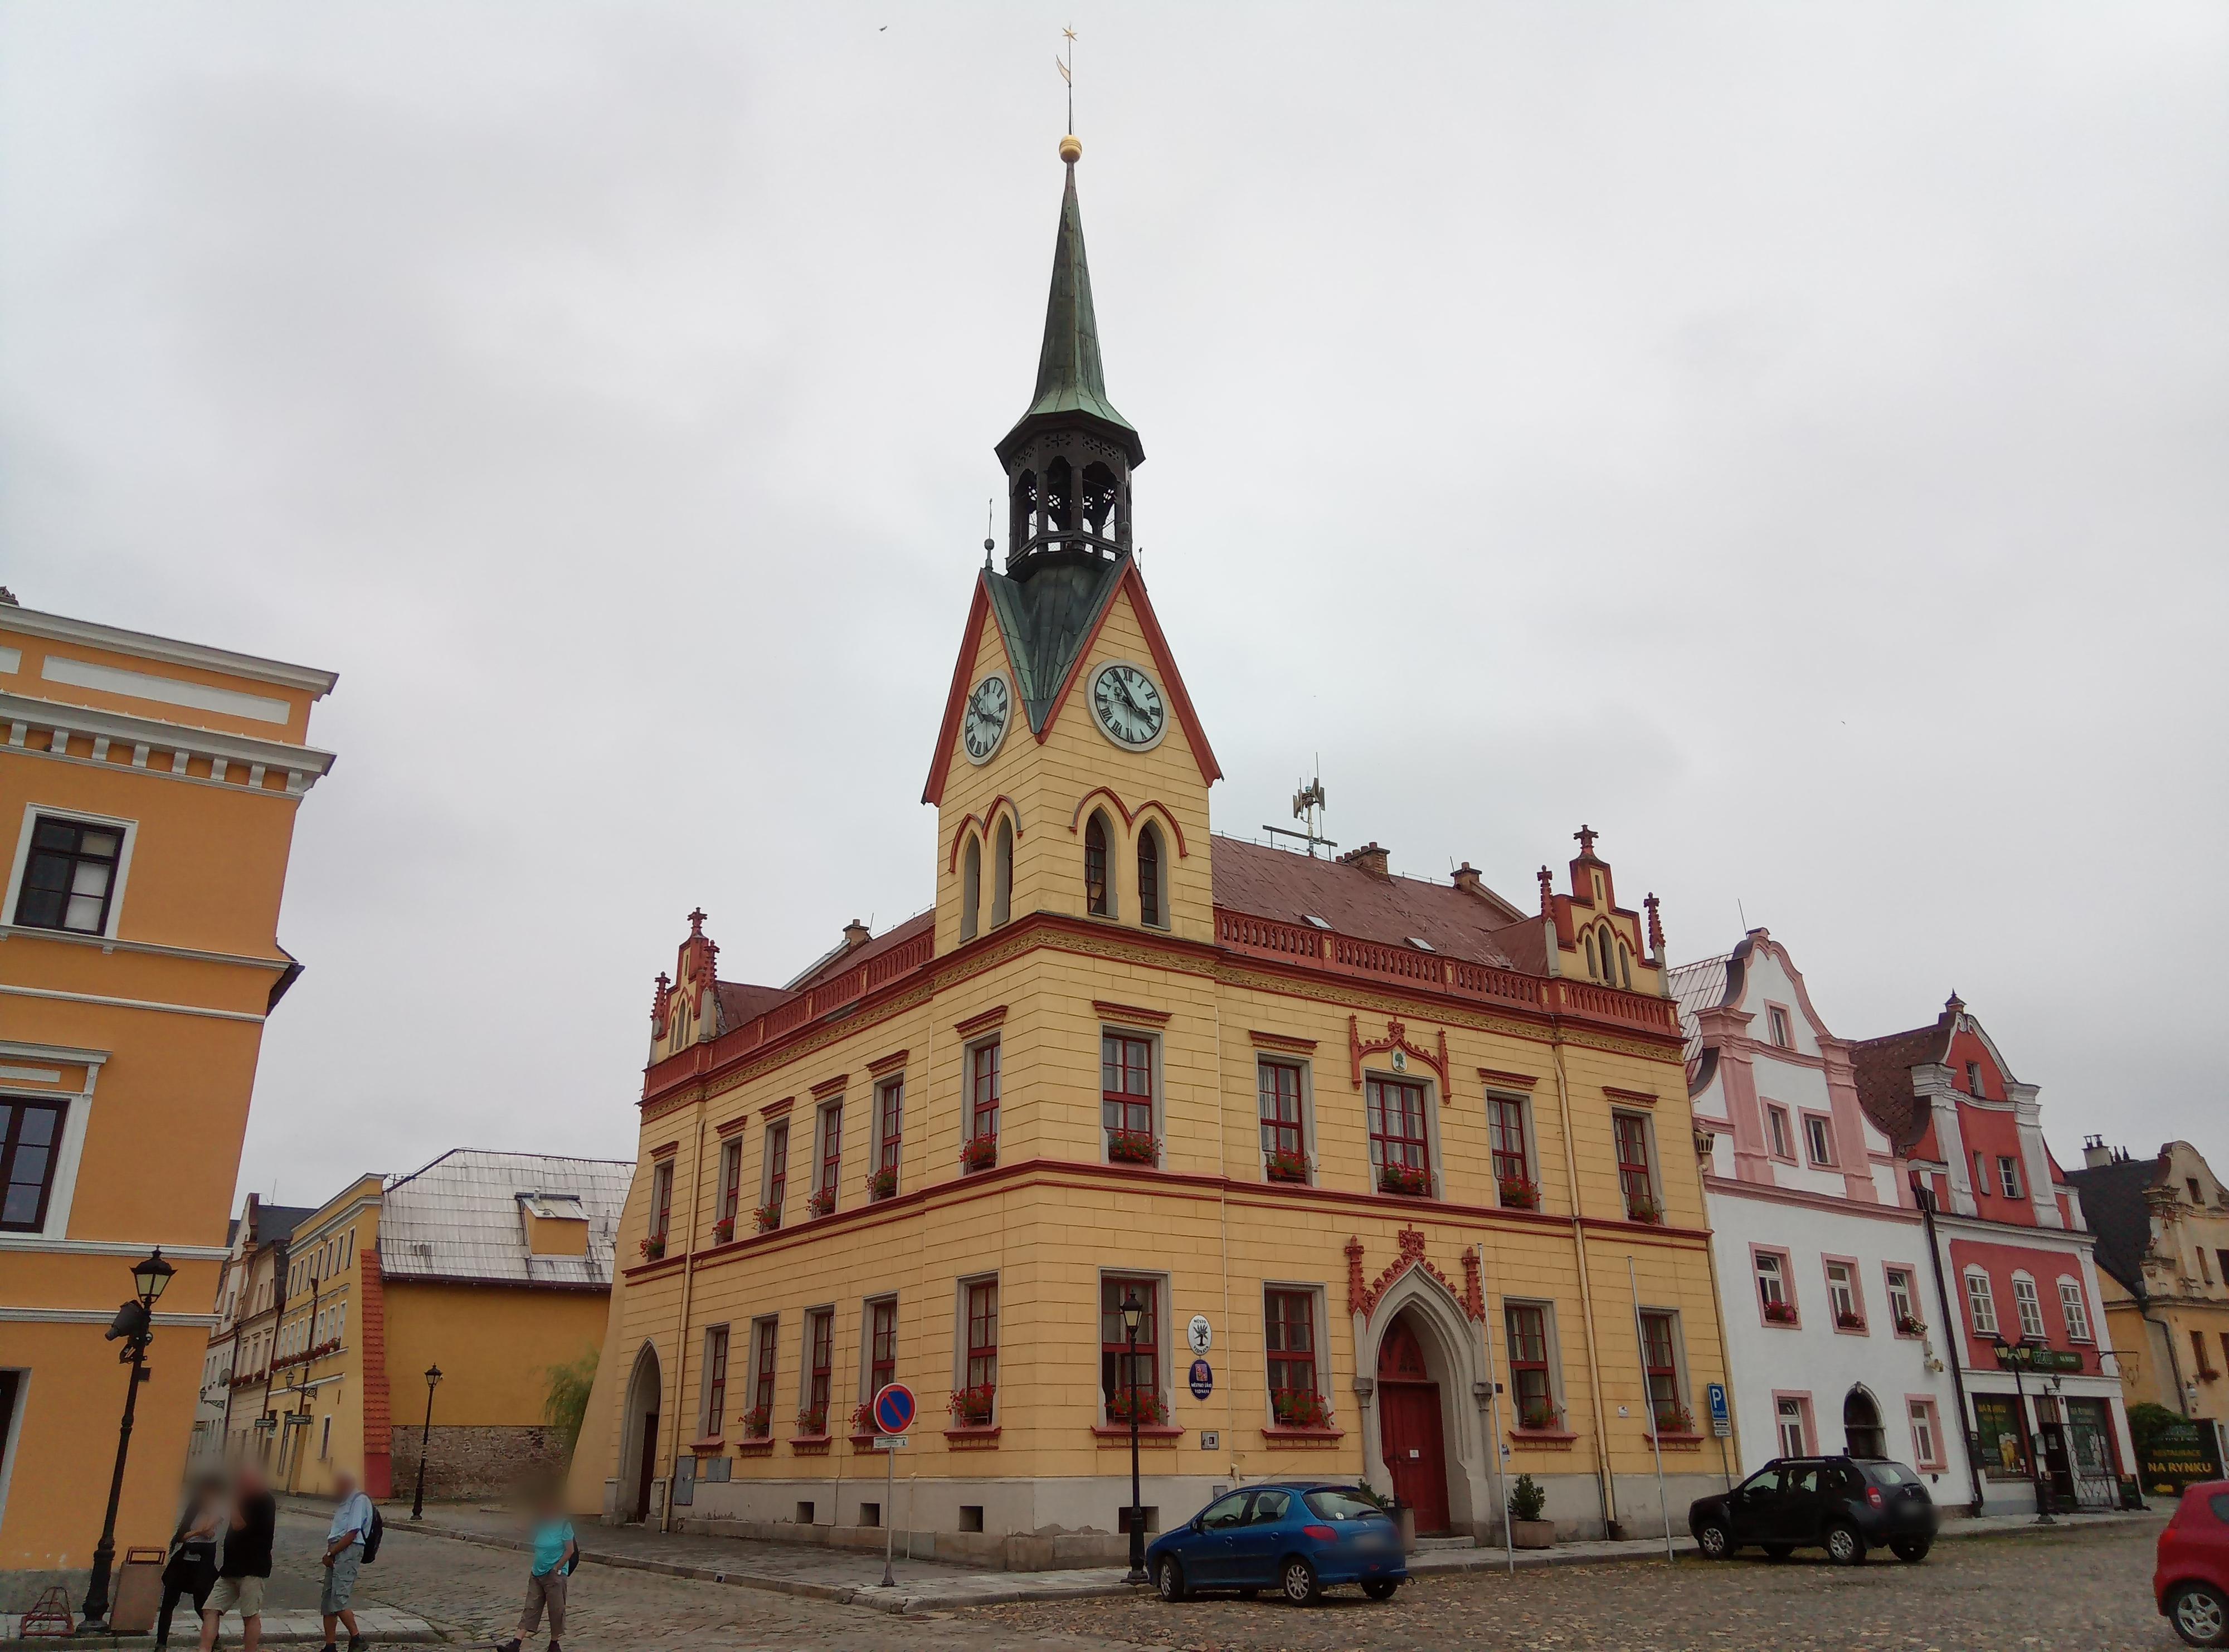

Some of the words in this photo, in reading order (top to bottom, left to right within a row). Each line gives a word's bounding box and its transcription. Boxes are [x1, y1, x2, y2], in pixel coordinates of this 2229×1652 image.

[992, 681, 997, 693] I
[1100, 678, 1111, 690] X
[1137, 679, 1145, 689] I
[996, 686, 1004, 700] II
[1145, 691, 1156, 700] II
[1111, 719, 1122, 735] VII
[1140, 728, 1147, 740] V
[1712, 1388, 1722, 1408] P
[2147, 1462, 2166, 1472] NA
[2168, 1462, 2212, 1474] RYNKU
